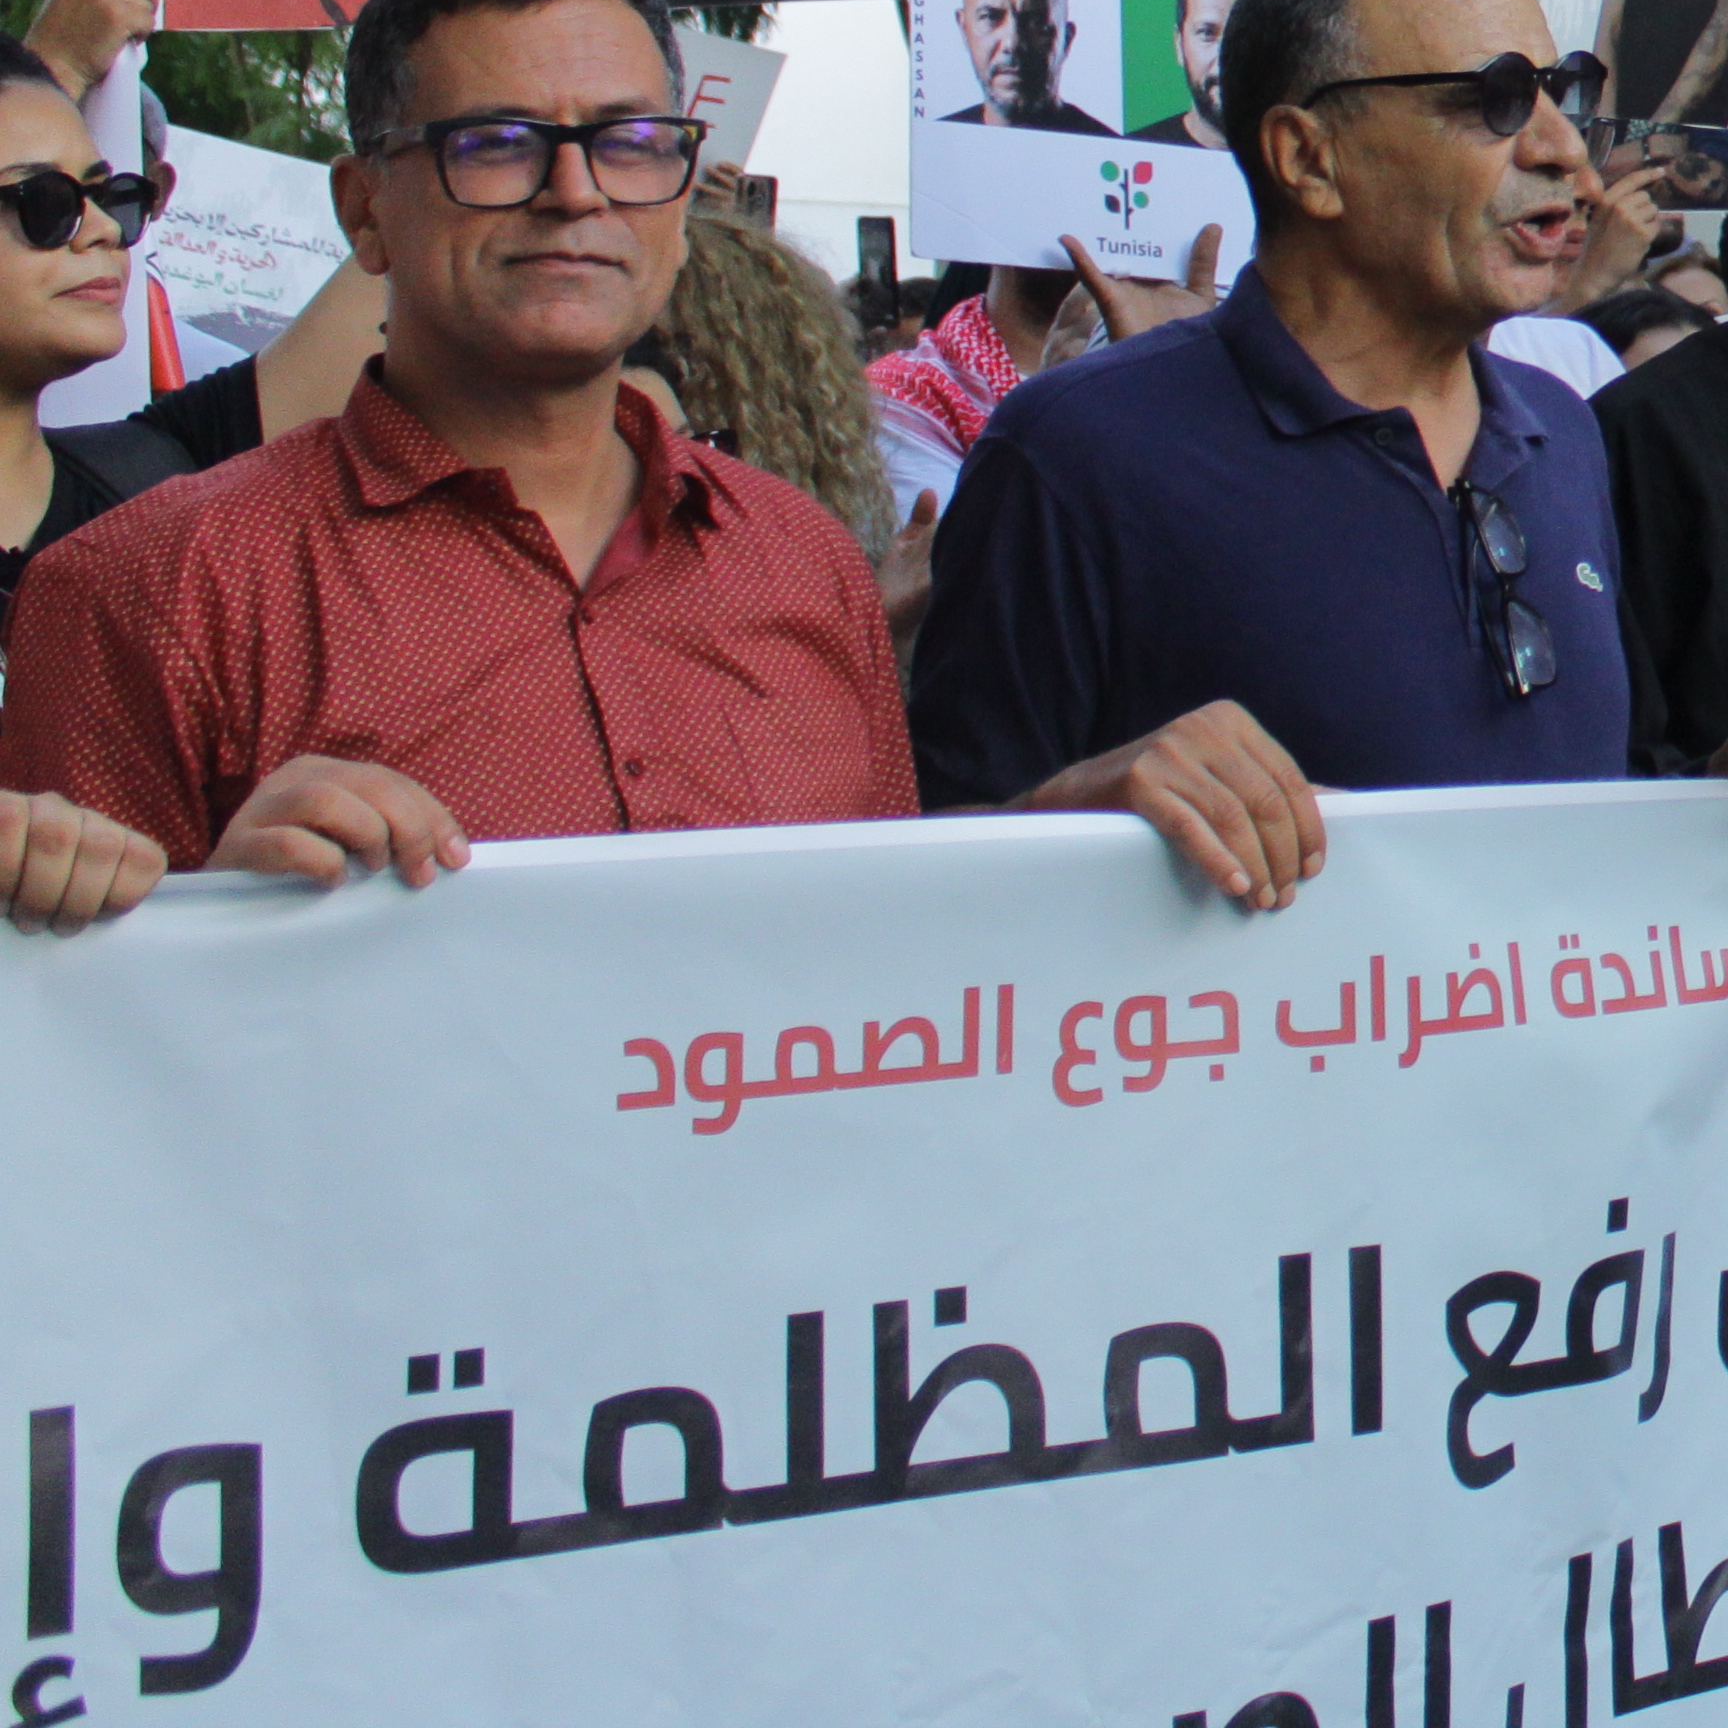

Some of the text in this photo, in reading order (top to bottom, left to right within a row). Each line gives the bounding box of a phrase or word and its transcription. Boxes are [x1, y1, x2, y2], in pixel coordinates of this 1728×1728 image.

[1097, 237, 1163, 258] Tunisia
[615, 980, 1015, 1136] الصمود
[1050, 986, 1240, 1107] جوع
[1277, 942, 1521, 1076] اضراب
[355, 1244, 1383, 1575] المظلمة
[1445, 1196, 1677, 1490] رفع
